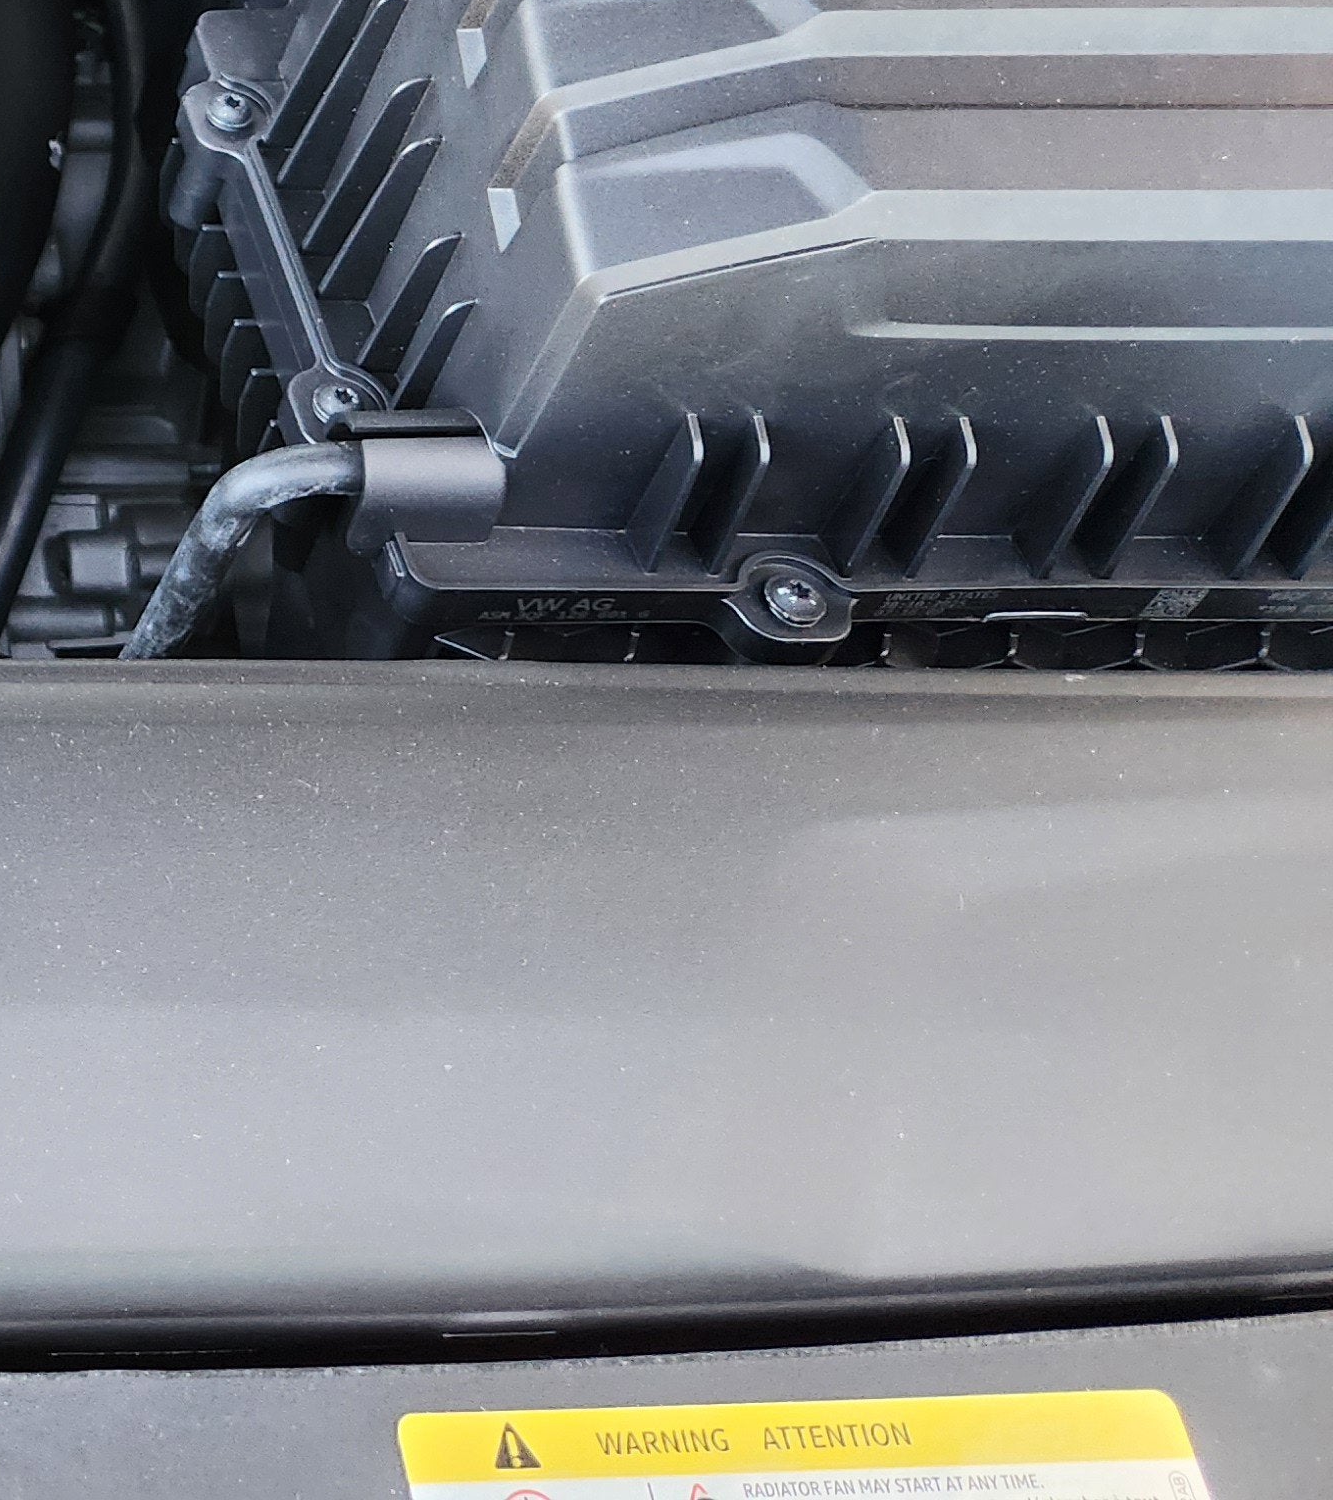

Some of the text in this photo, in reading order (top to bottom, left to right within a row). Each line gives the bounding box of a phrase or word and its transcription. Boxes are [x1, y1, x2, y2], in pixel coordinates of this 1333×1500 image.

[516, 597, 617, 613] VW AG
[595, 1421, 912, 1456] WARNING ATTENTION
[743, 1473, 1045, 1499] RADIATOR FAN MAY START AT ANY TIME.
